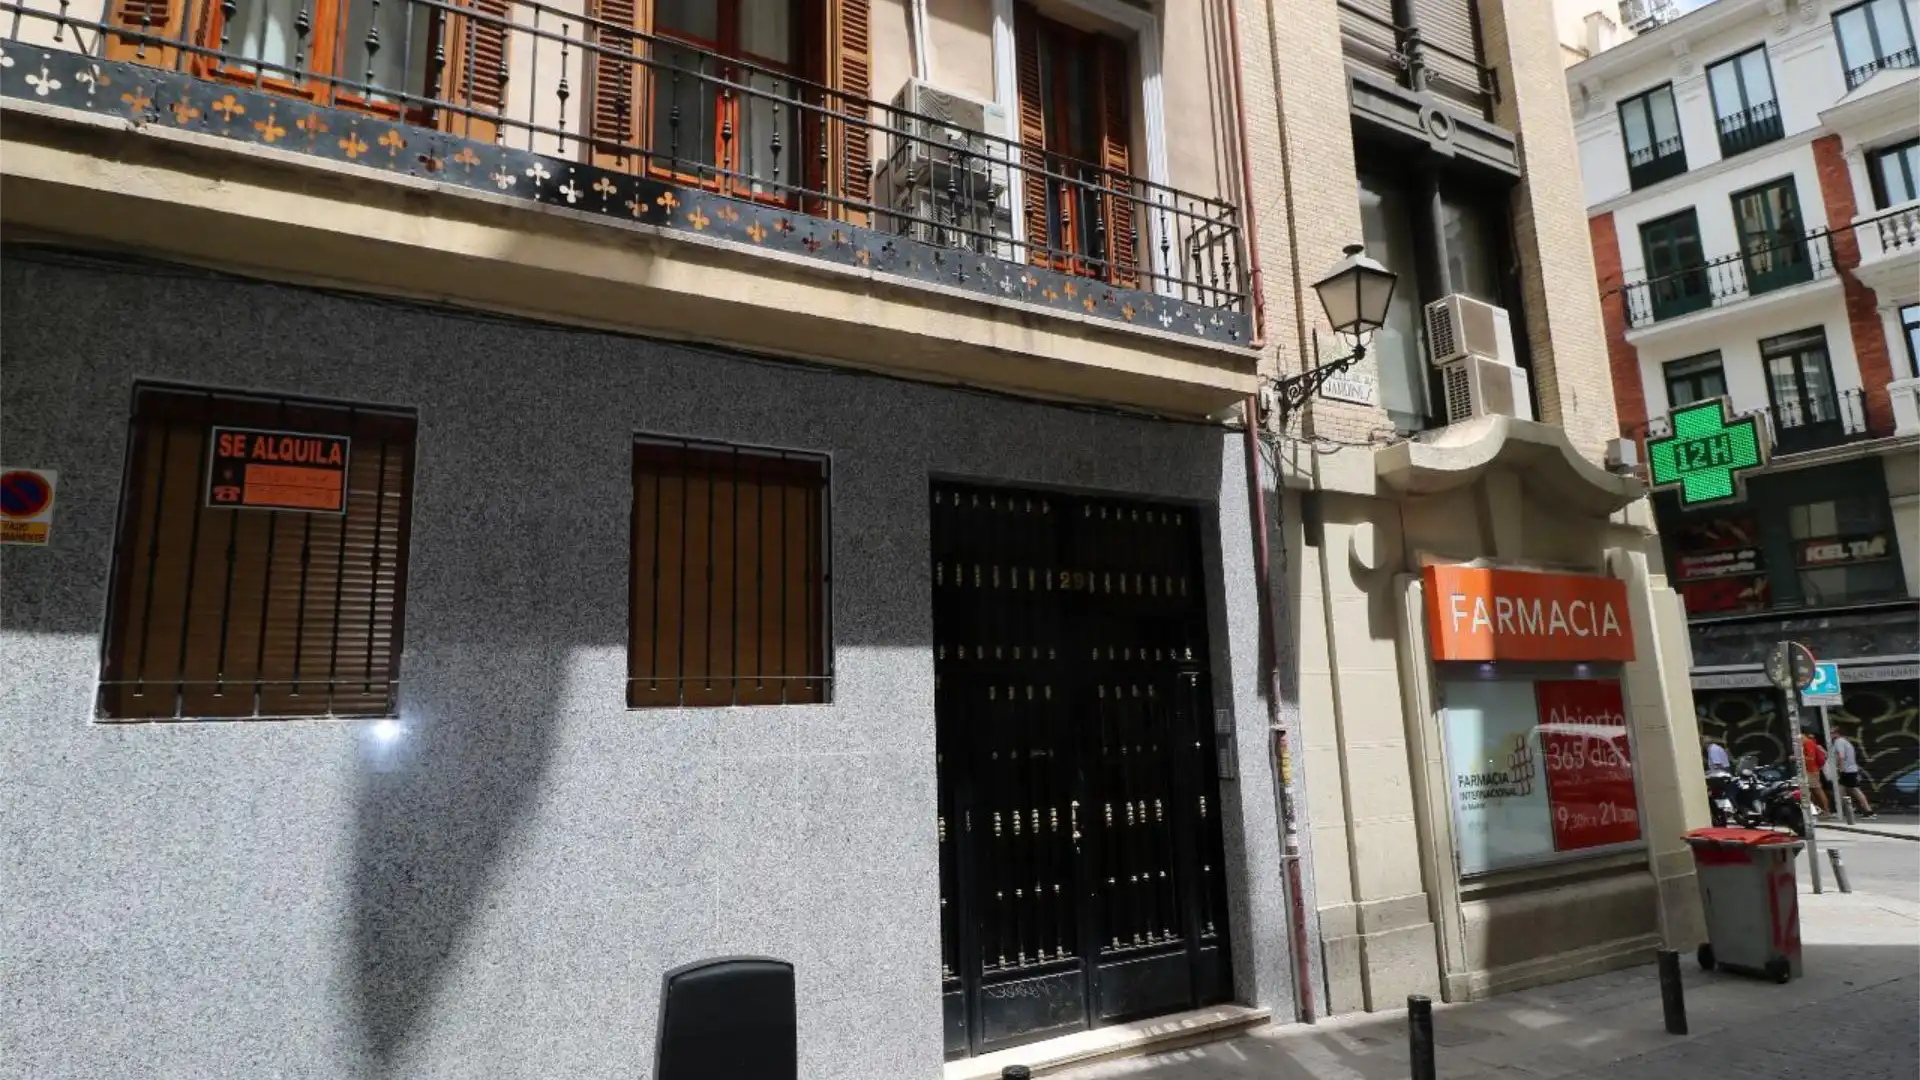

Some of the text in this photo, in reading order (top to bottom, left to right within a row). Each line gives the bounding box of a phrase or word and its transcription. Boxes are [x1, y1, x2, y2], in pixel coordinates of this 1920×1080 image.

[219, 433, 342, 465] SE ALQUILA
[1675, 435, 1730, 470] 12H
[1060, 571, 1084, 590] 29
[1450, 594, 1622, 637] FARMACIA
[1549, 741, 1585, 770] 365
[1457, 772, 1509, 788] FARMACIA
